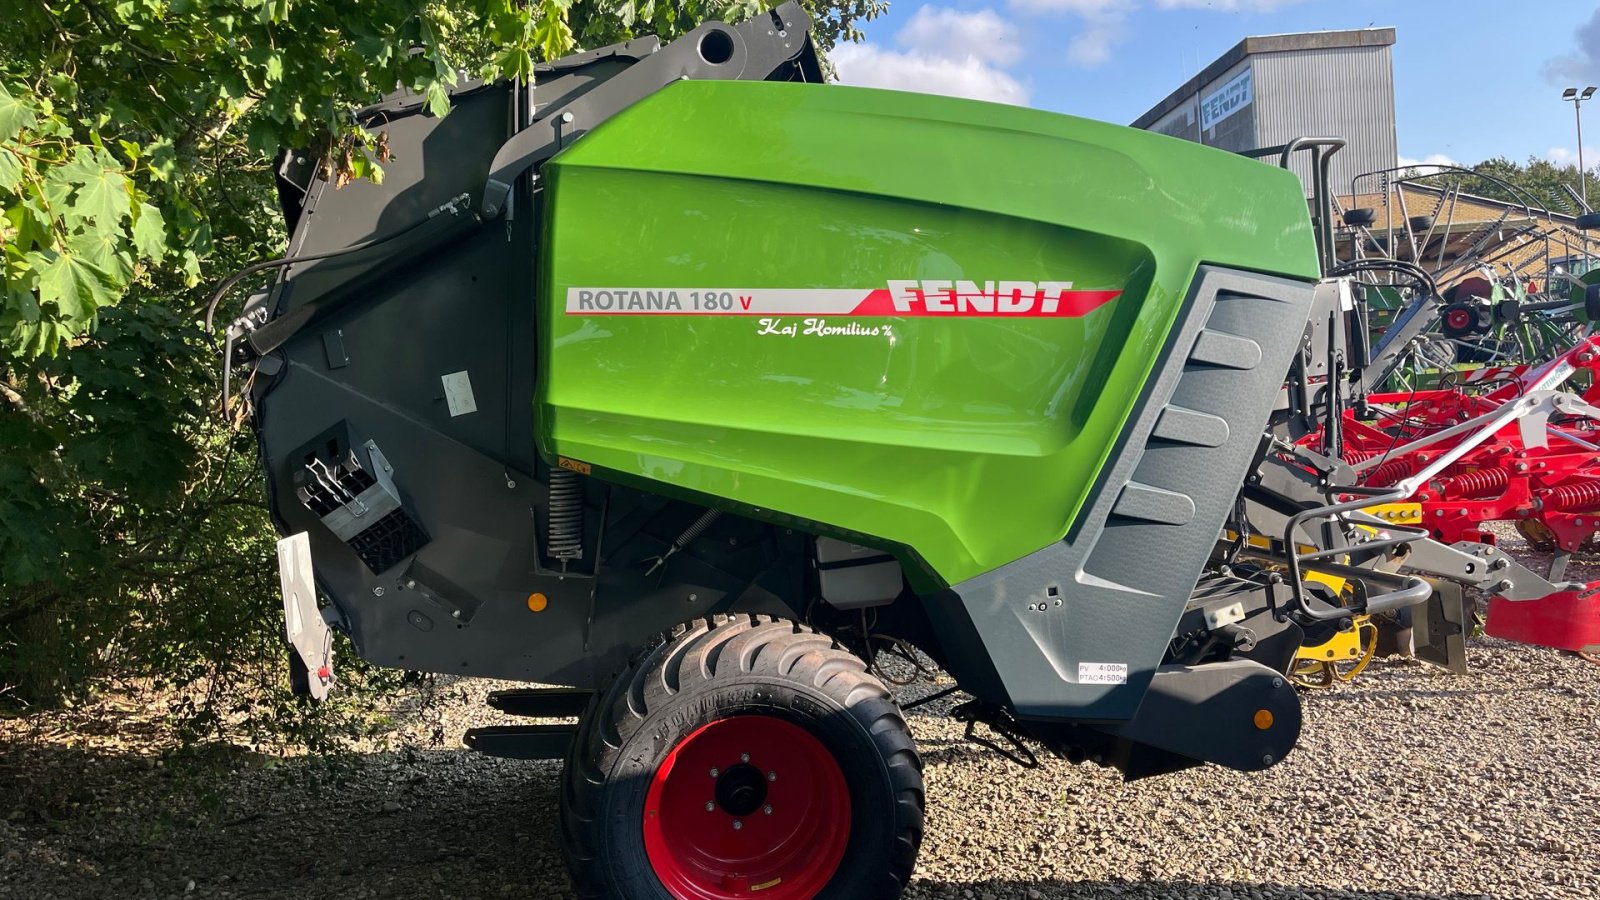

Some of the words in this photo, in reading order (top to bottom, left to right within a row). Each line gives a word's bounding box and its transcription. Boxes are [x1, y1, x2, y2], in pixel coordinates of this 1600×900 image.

[1203, 75, 1250, 124] FENDT
[578, 290, 682, 310] ROTANA
[690, 292, 734, 310] 180
[887, 280, 1073, 313] FENDT
[757, 318, 797, 338] Kaj
[803, 318, 880, 337] Homilius
